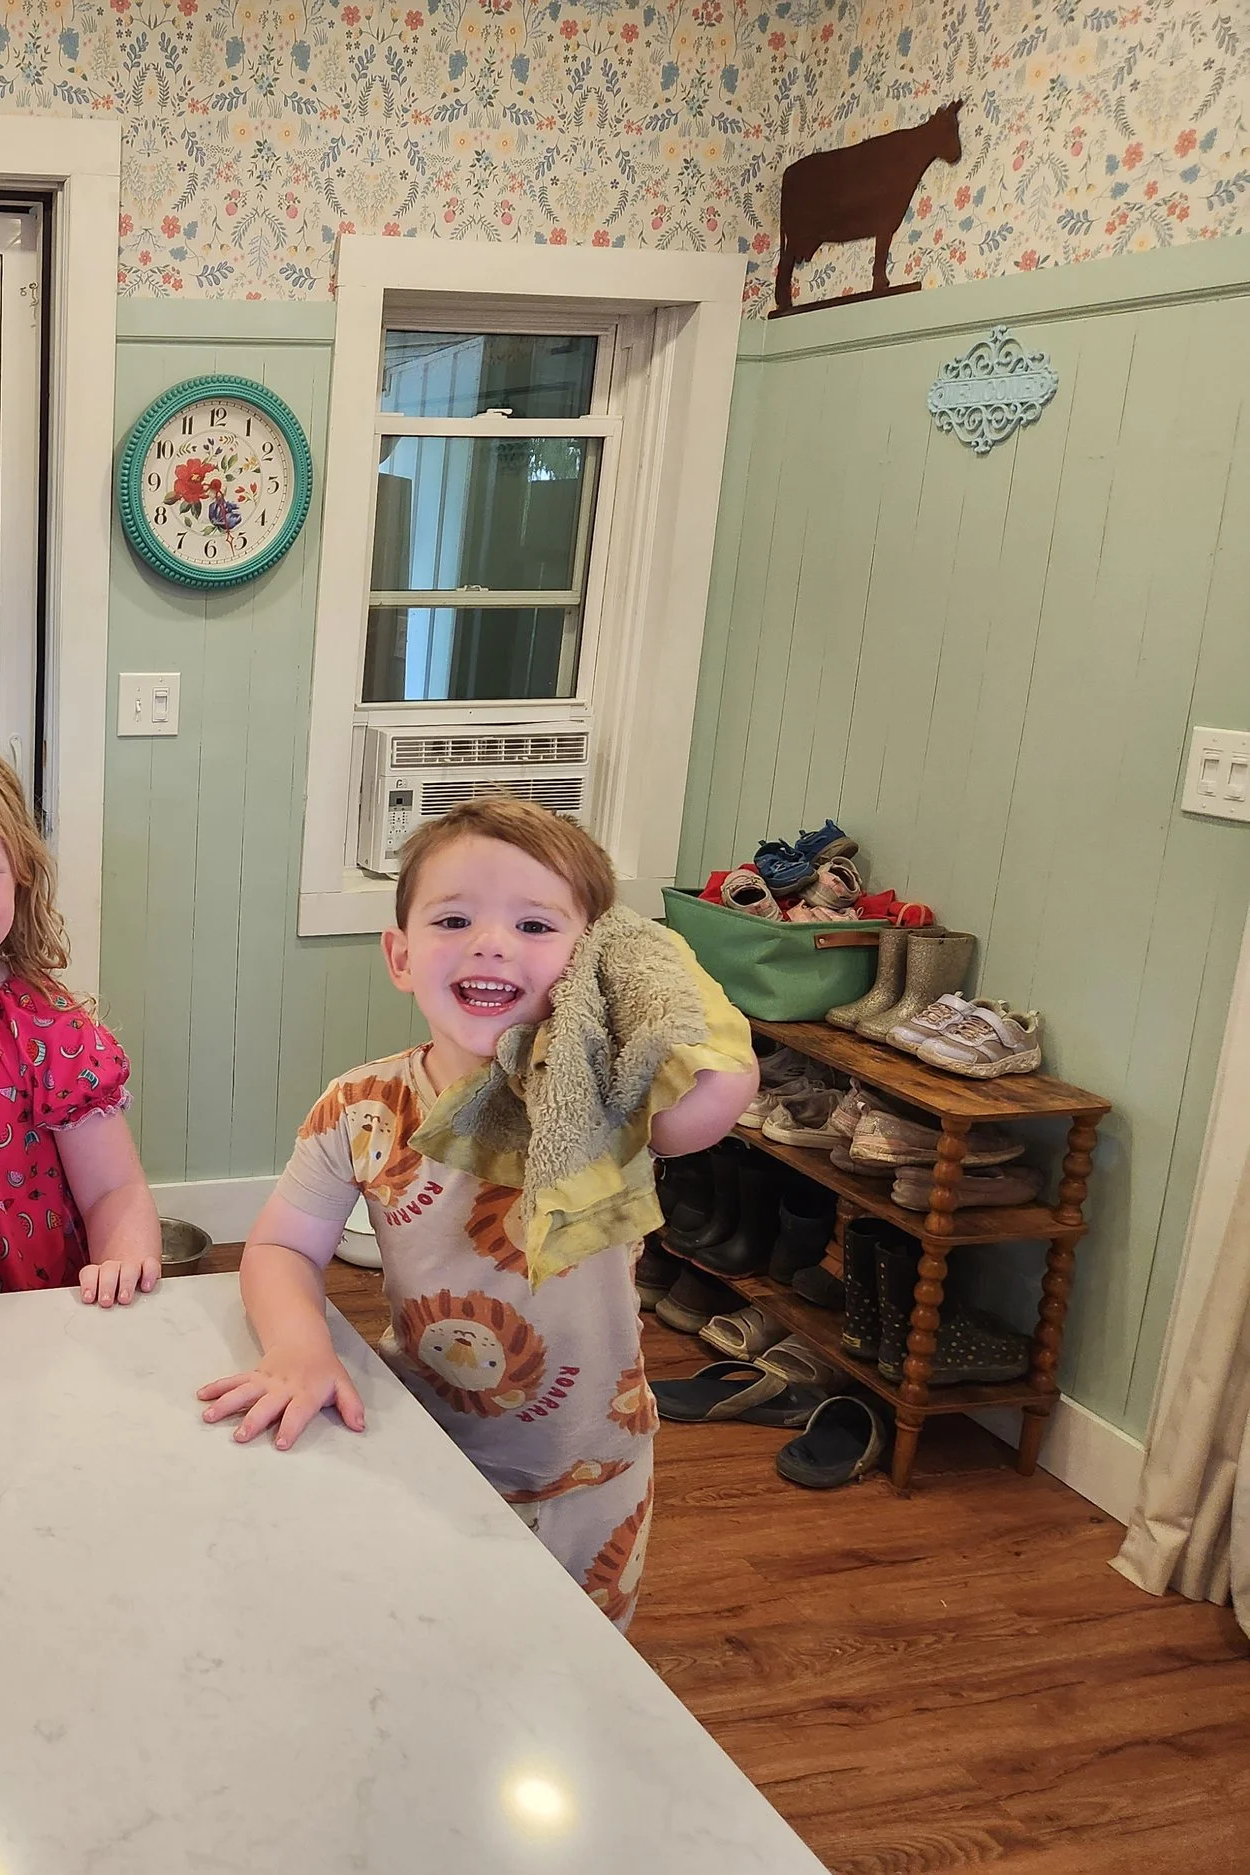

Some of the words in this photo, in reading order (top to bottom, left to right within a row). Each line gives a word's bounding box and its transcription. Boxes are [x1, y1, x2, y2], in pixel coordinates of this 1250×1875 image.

[182, 416, 193, 435] 11
[210, 407, 228, 427] 12
[246, 417, 251, 436] 1
[156, 440, 174, 459] 10
[262, 442, 274, 461] 2
[148, 473, 161, 491] 9
[267, 476, 280, 494] 3
[154, 506, 167, 525] 8
[255, 509, 268, 526] 4
[177, 532, 188, 550] 7
[204, 539, 217, 559] 6
[234, 532, 247, 550] 5
[383, 1180, 444, 1227] ROARRR
[514, 1366, 581, 1423] ROARRR
